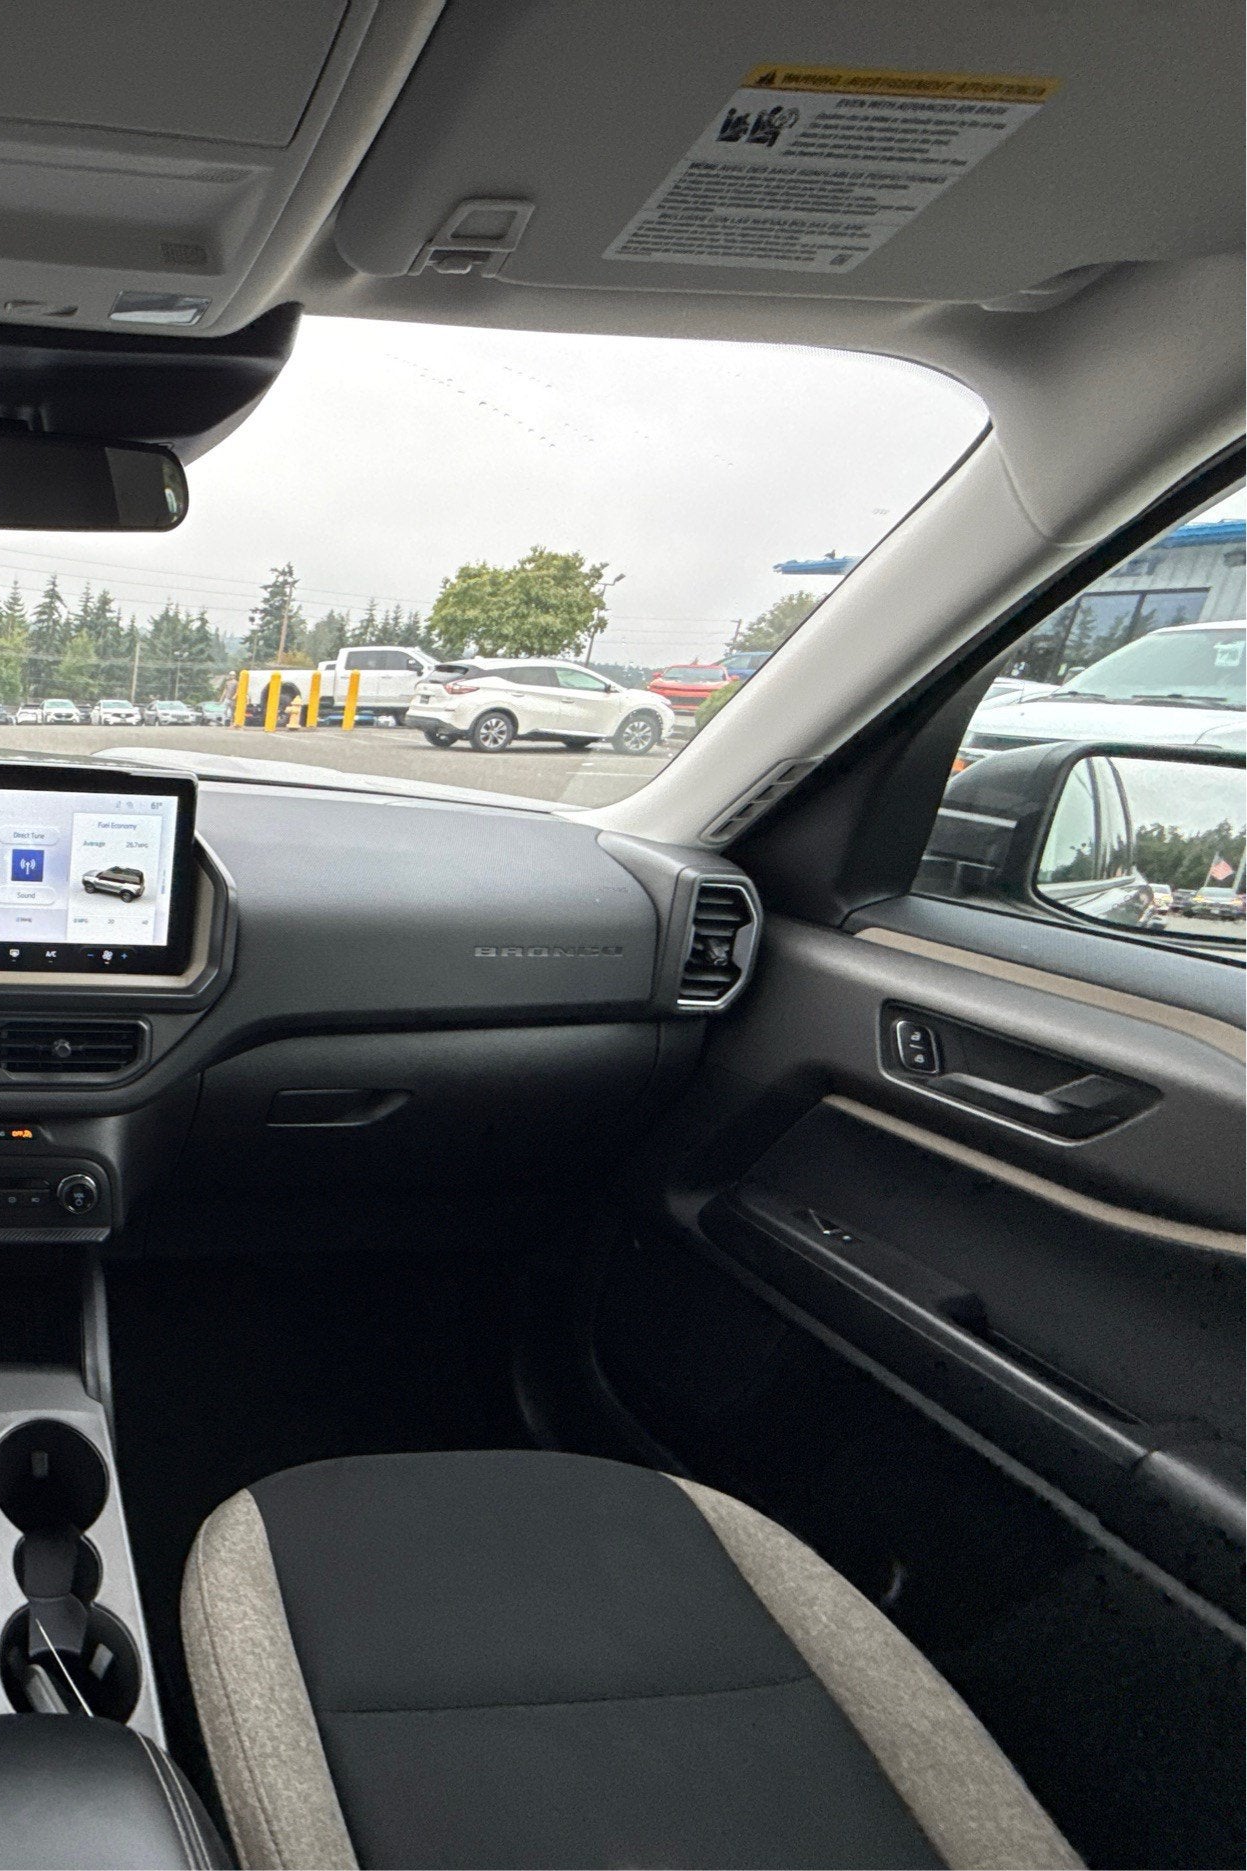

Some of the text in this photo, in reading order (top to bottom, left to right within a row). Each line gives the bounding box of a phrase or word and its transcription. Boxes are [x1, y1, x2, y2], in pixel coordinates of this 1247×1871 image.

[97, 821, 138, 831] Fuel Economy
[13, 831, 46, 840] Direct Tune
[82, 840, 106, 848] Average
[45, 950, 58, 959] A/C
[474, 946, 623, 957] BRONCO
